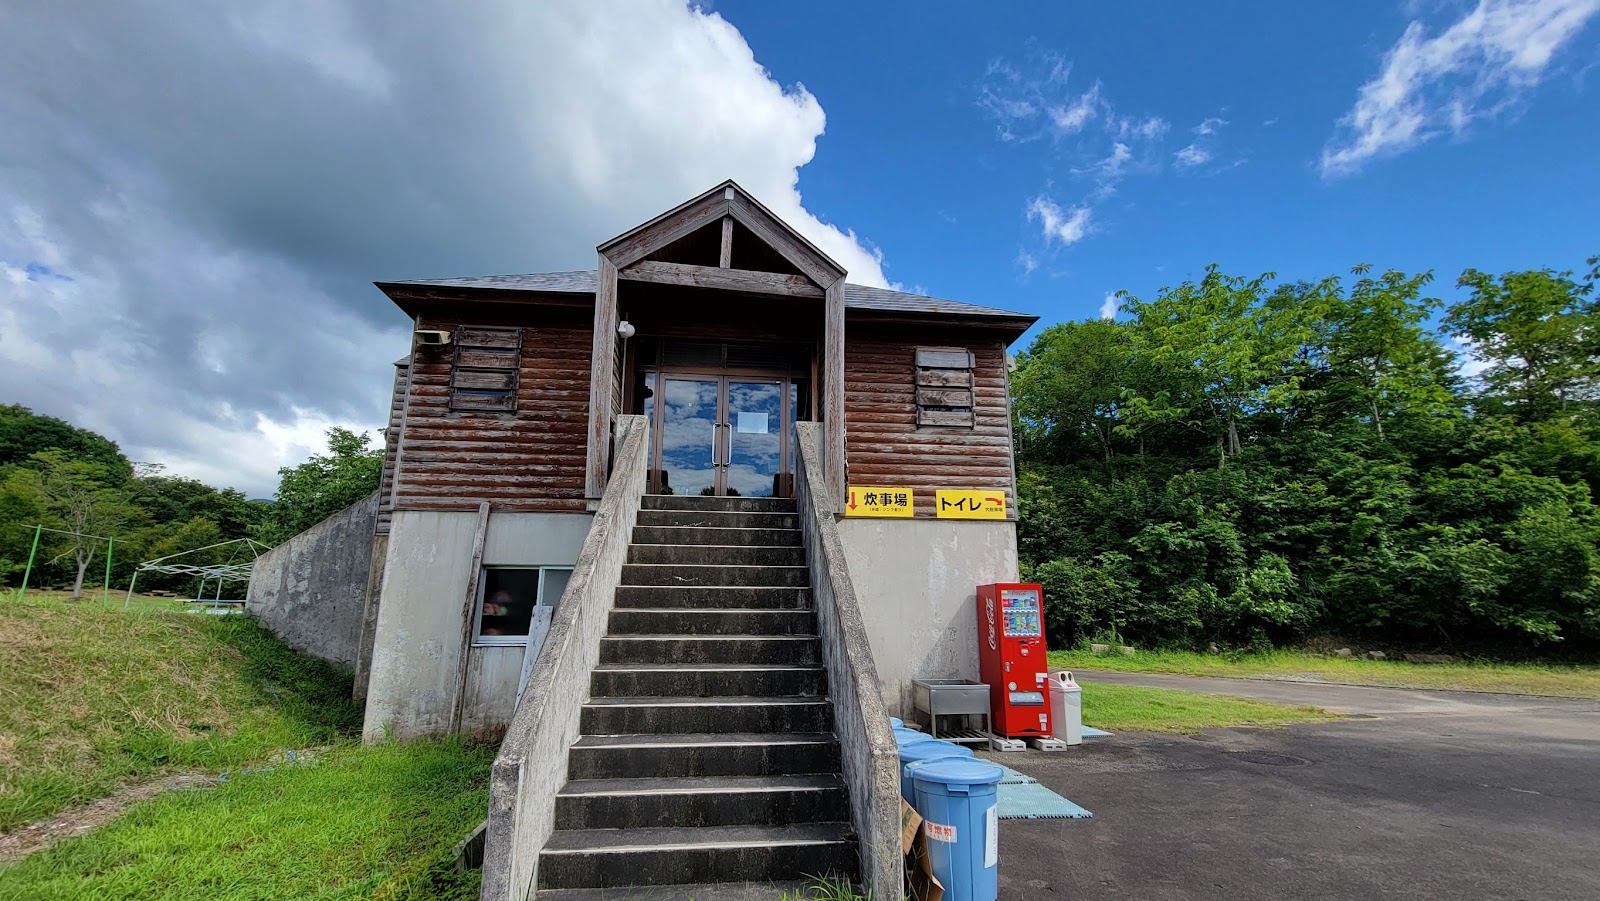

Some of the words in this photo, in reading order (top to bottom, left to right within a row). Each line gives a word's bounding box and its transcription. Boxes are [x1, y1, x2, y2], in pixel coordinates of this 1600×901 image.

[864, 492, 907, 507] 炊事場
[941, 497, 982, 511] トイレ
[927, 822, 952, 837] 可燃物
